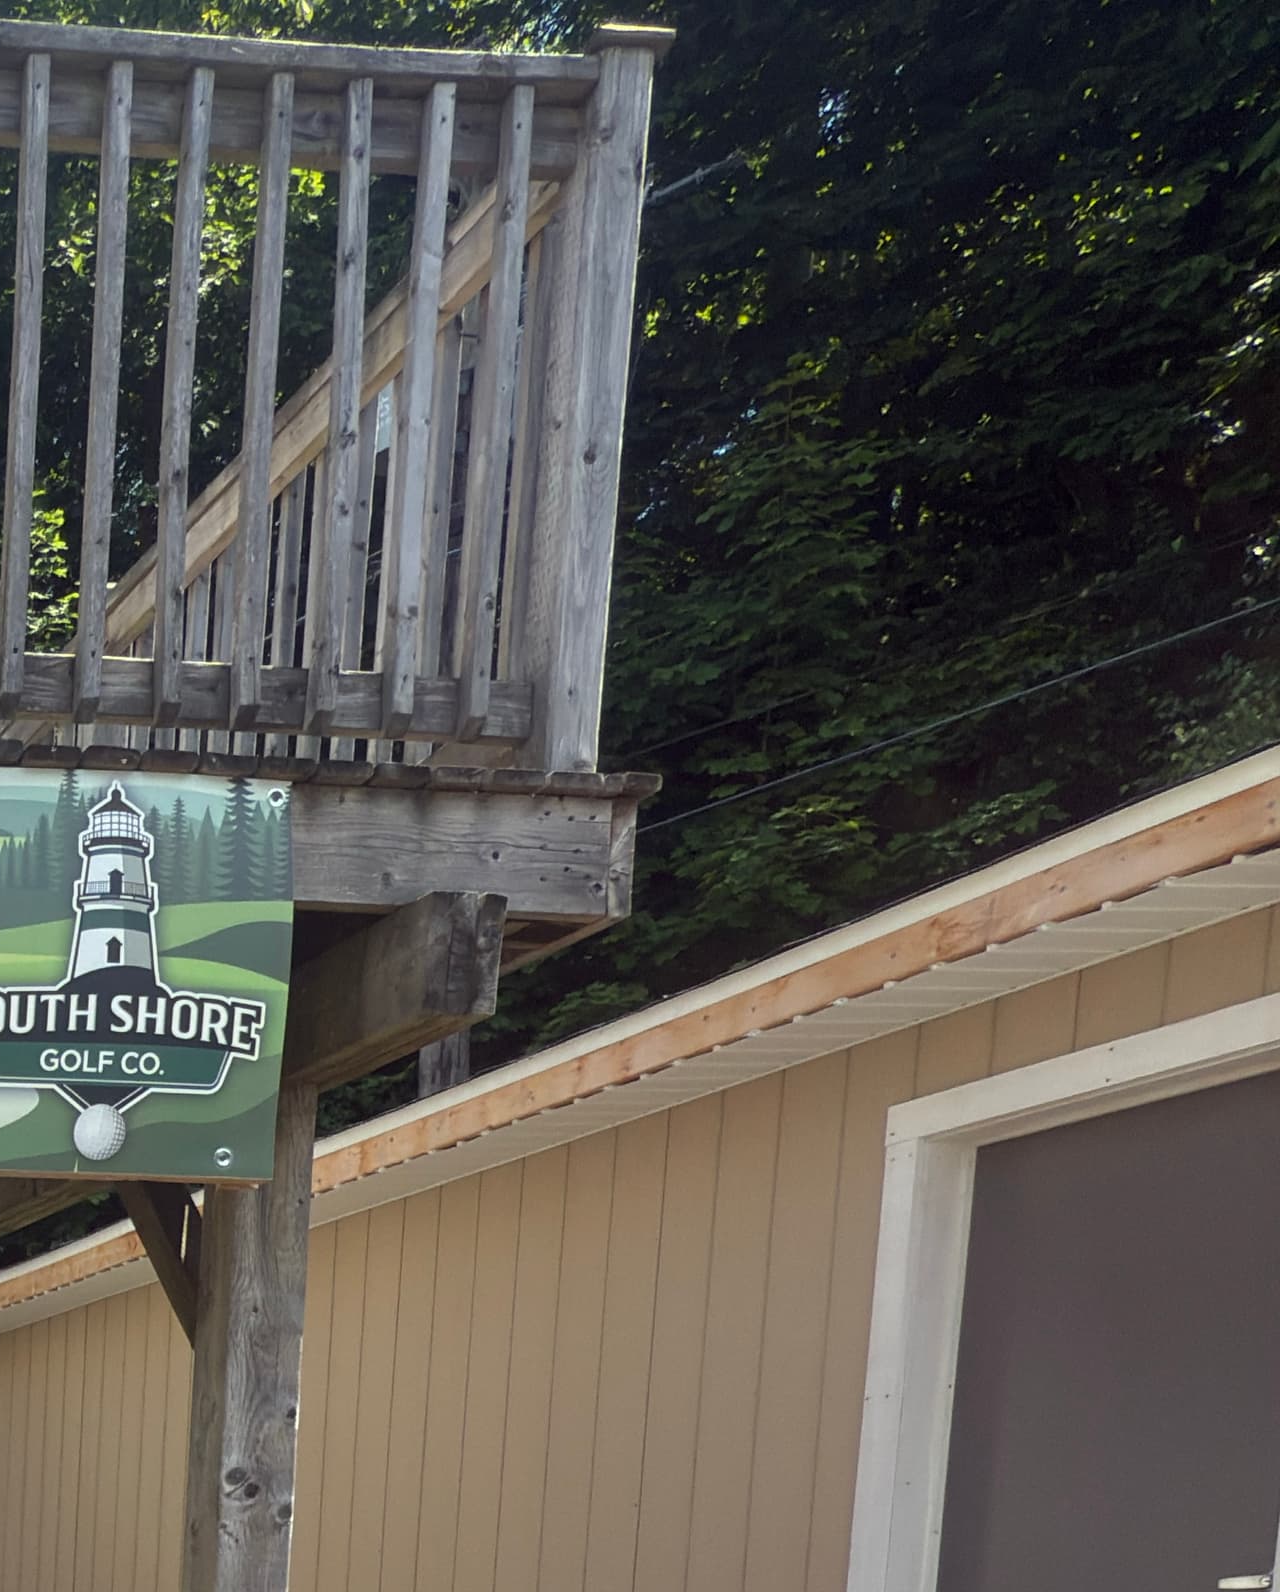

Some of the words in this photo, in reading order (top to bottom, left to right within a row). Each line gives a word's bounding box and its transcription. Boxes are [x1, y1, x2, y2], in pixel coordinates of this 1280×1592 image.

[111, 995, 262, 1051] SHORE
[39, 1048, 113, 1075] GOLF
[120, 1050, 165, 1077] CO.
